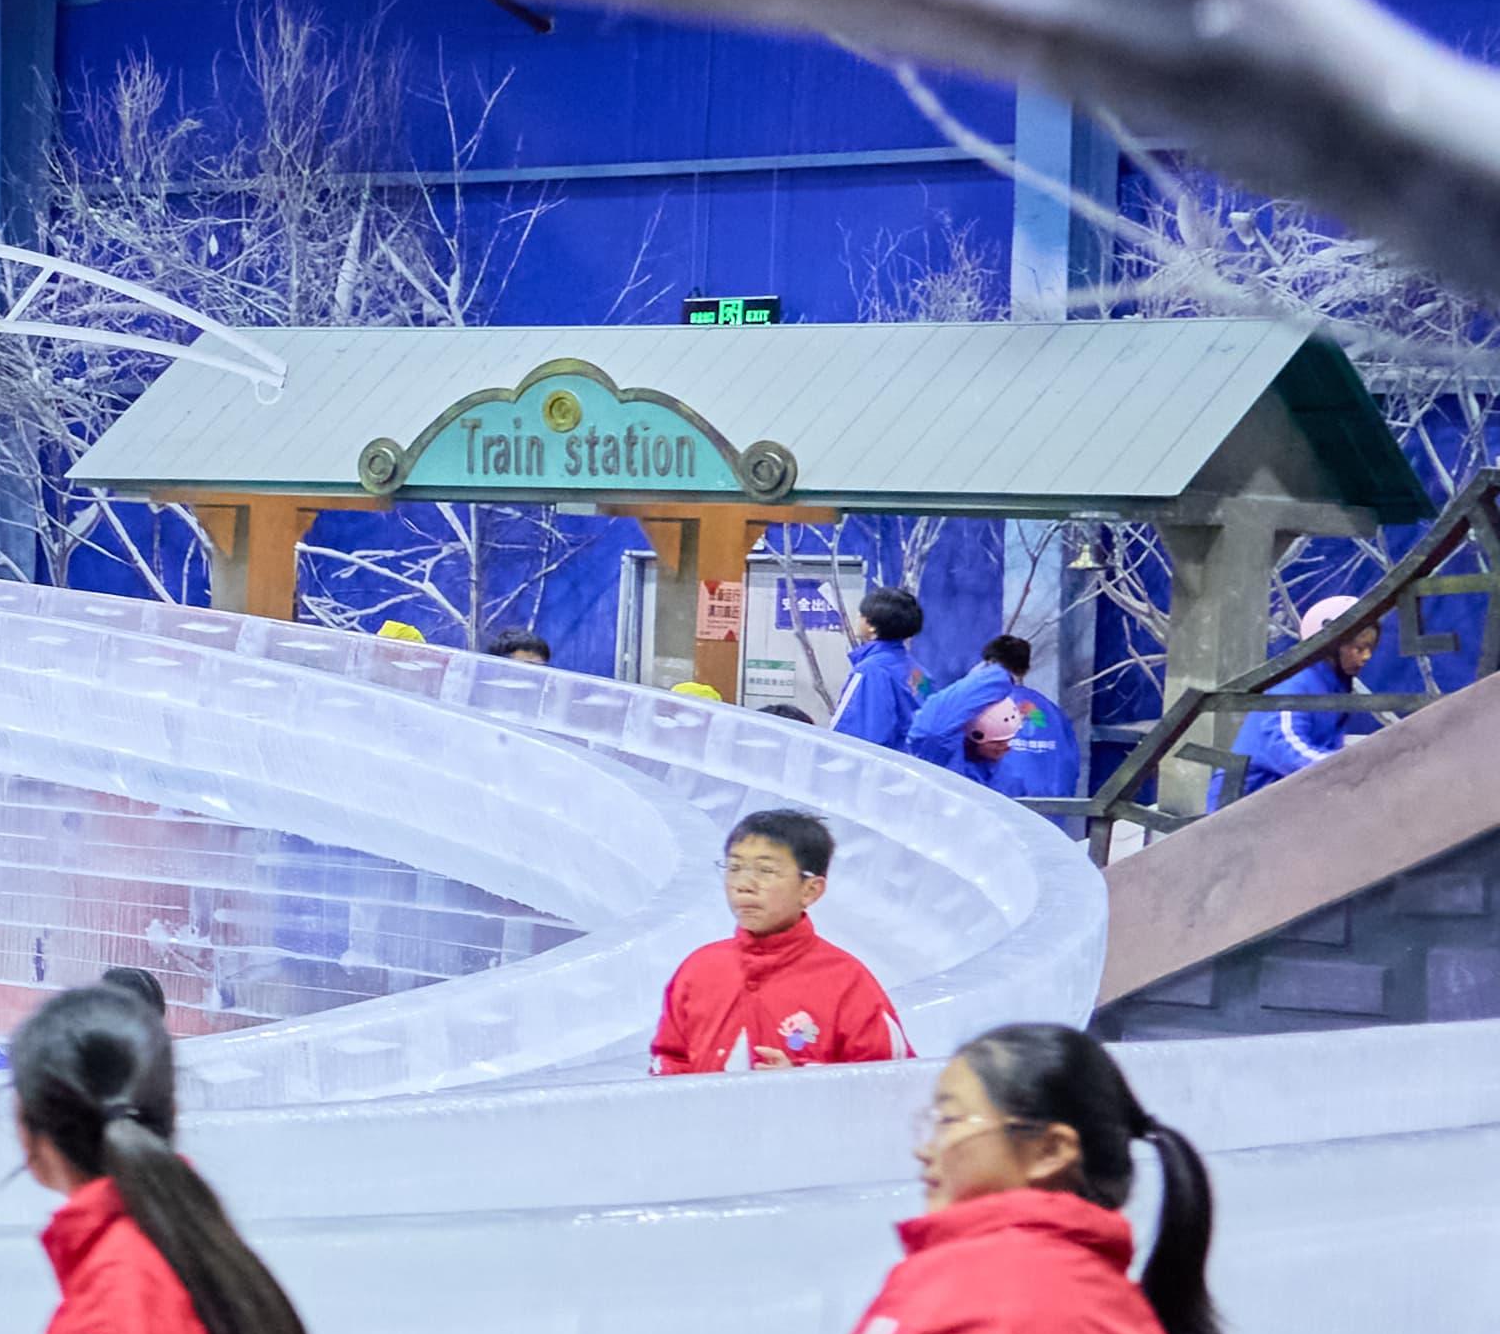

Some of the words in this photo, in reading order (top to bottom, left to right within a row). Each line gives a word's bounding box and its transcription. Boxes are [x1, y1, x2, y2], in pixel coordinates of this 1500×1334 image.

[746, 310, 770, 322] EXIT
[460, 418, 544, 475] Train
[564, 424, 695, 477] station
